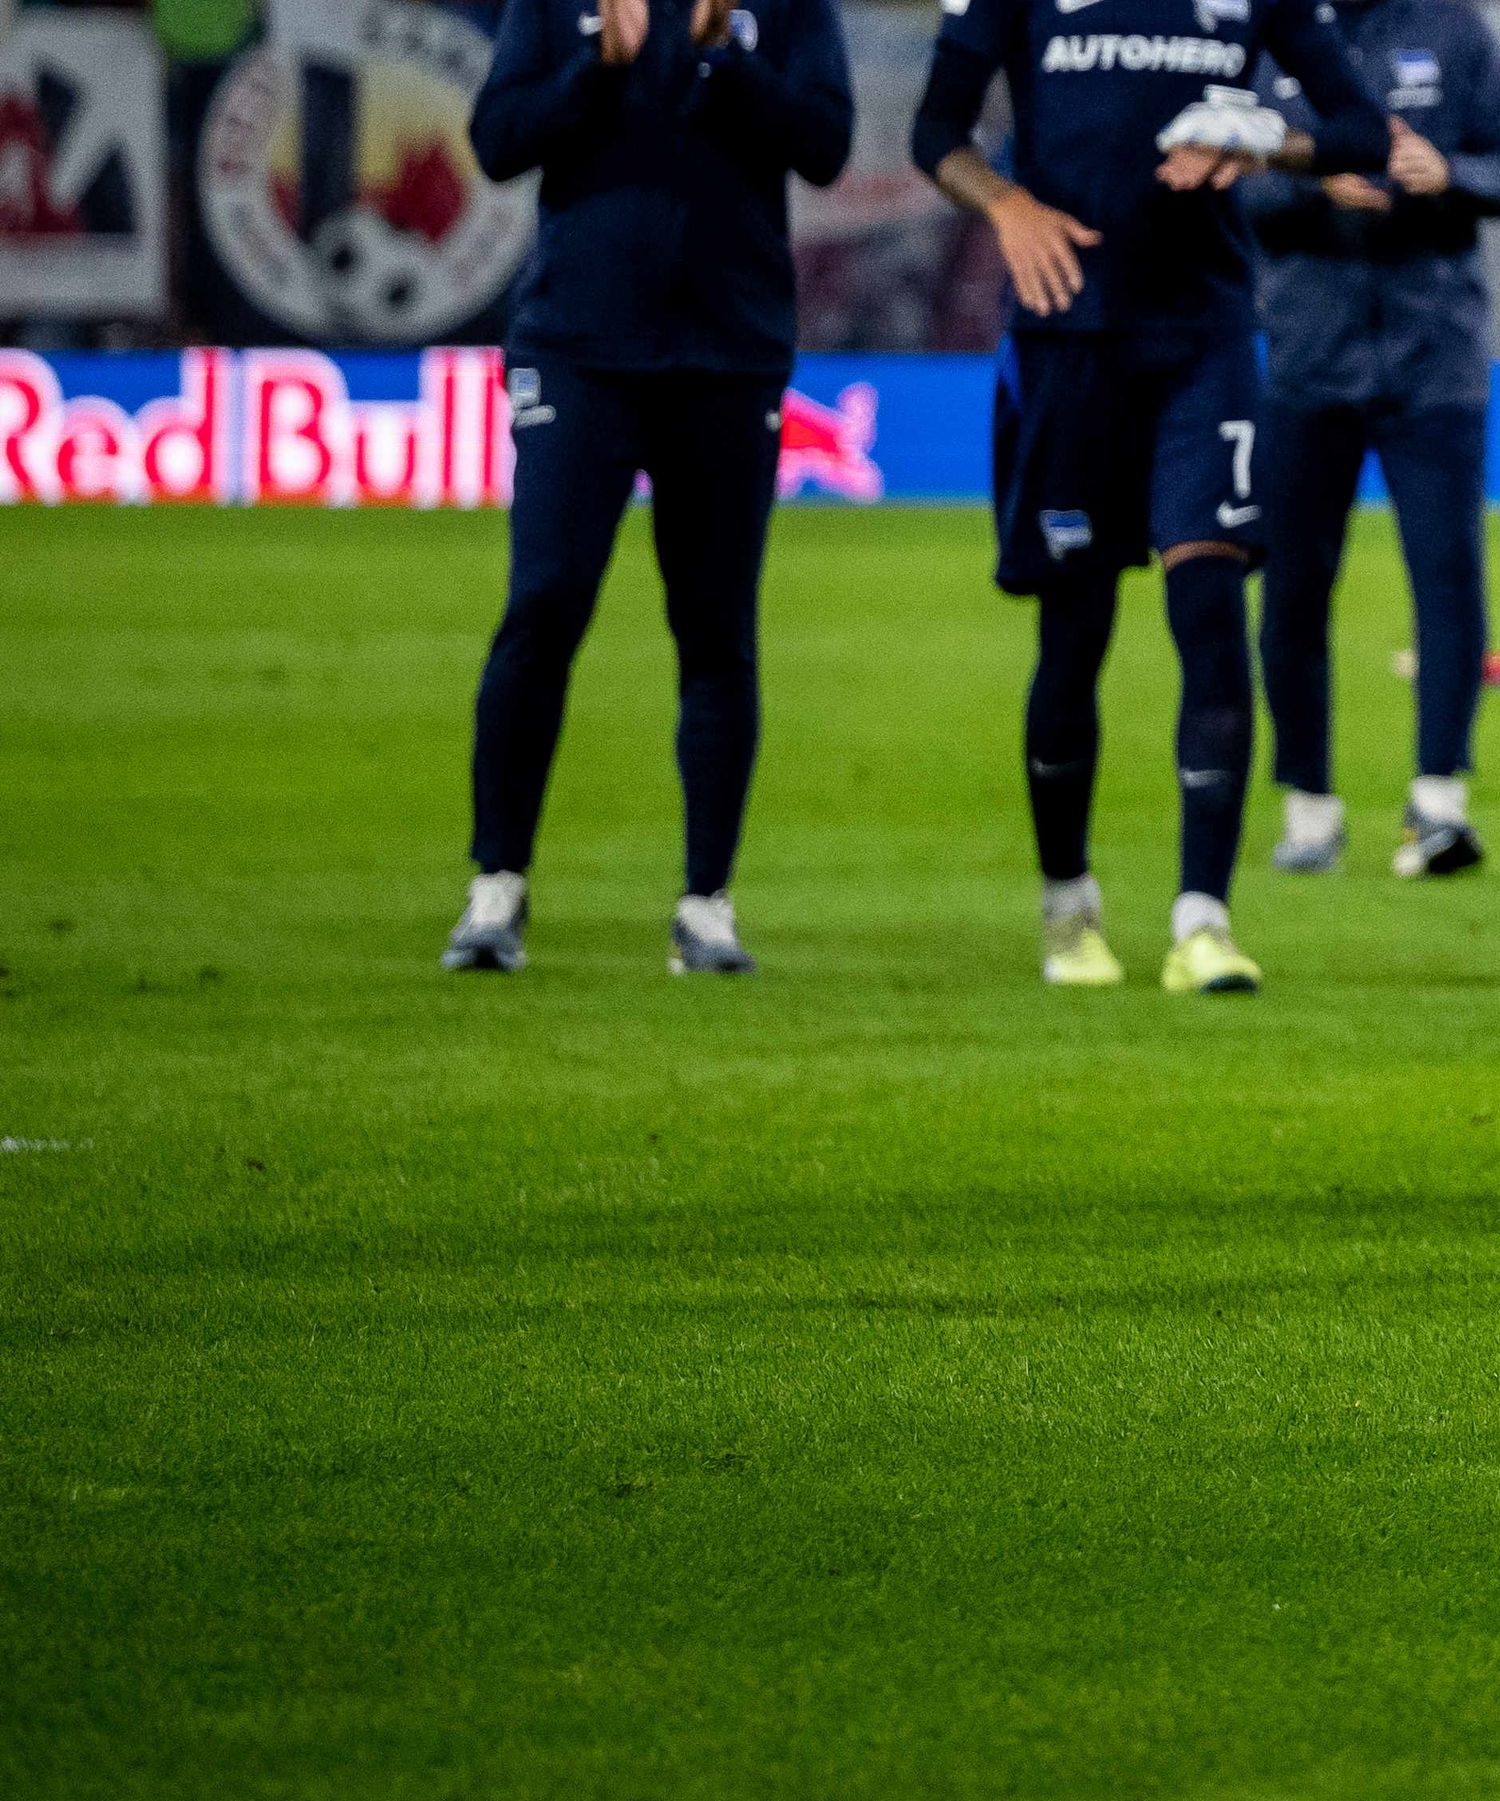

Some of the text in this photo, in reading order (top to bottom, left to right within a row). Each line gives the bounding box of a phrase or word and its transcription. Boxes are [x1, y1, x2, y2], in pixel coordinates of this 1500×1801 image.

[1042, 34, 1246, 78] AUTOHERO
[256, 347, 508, 502] Bull
[1218, 419, 1256, 499] 7
